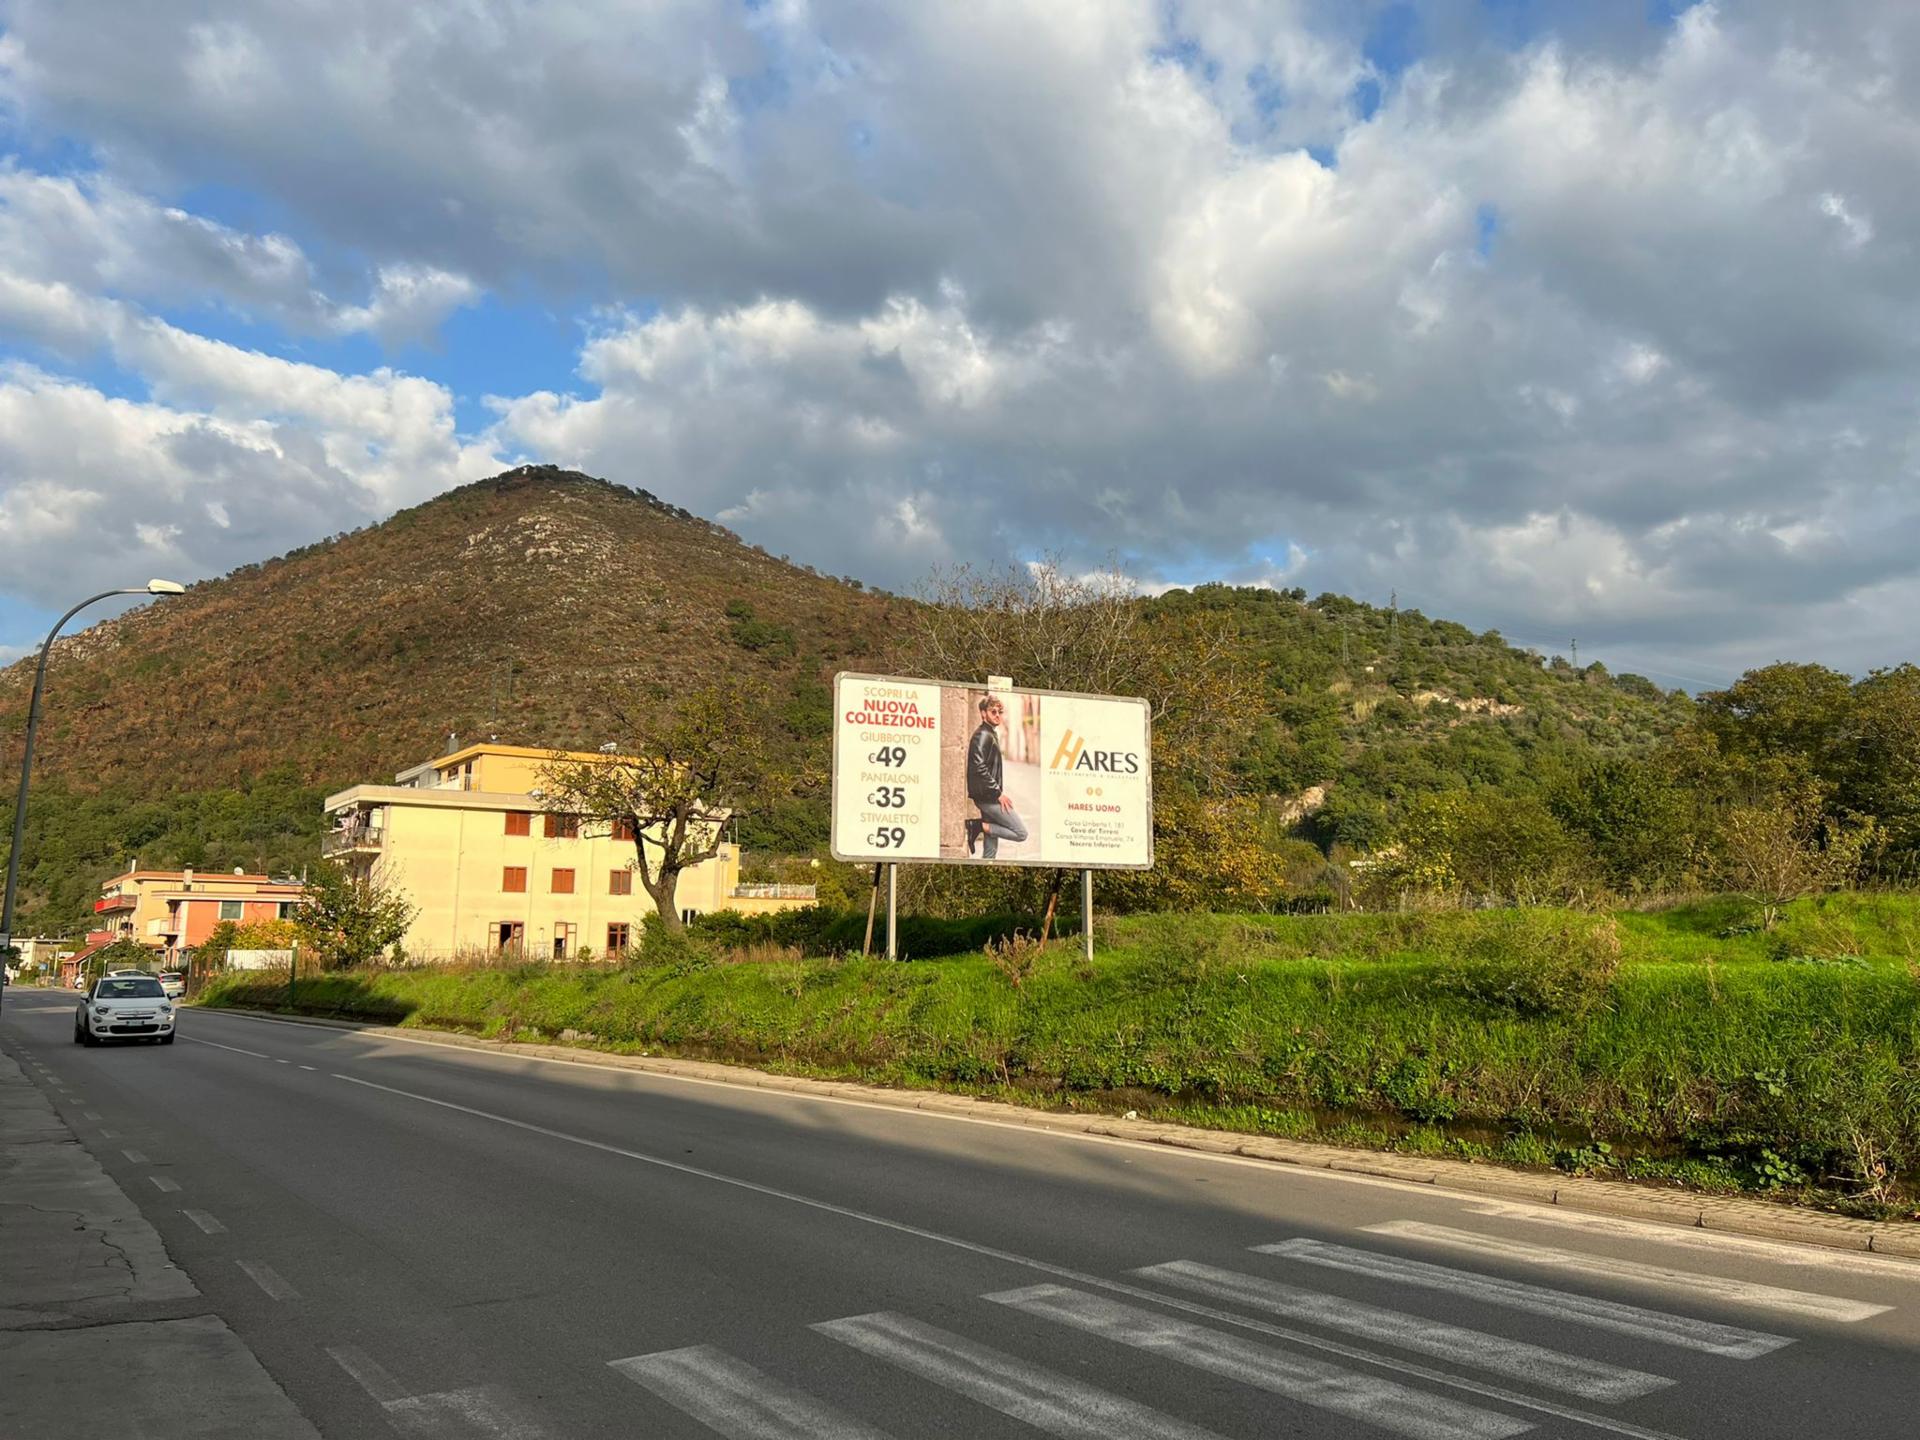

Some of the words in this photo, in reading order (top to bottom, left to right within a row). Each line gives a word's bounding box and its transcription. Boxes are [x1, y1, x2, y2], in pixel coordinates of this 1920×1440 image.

[863, 686, 902, 699] SCOPRI
[905, 689, 918, 700] LA
[863, 699, 918, 714] NUOVA
[845, 711, 936, 729] COLLEZIONE
[860, 731, 921, 745] GIUBBOTTO
[868, 746, 907, 767] €49
[1049, 728, 1139, 774] HARES
[860, 772, 920, 784] PANTALONI
[867, 786, 906, 808] €35
[1067, 803, 1094, 811] HARES
[1095, 804, 1121, 813] UOMO
[860, 812, 919, 824] STIVALETTO
[866, 827, 906, 849] €59
